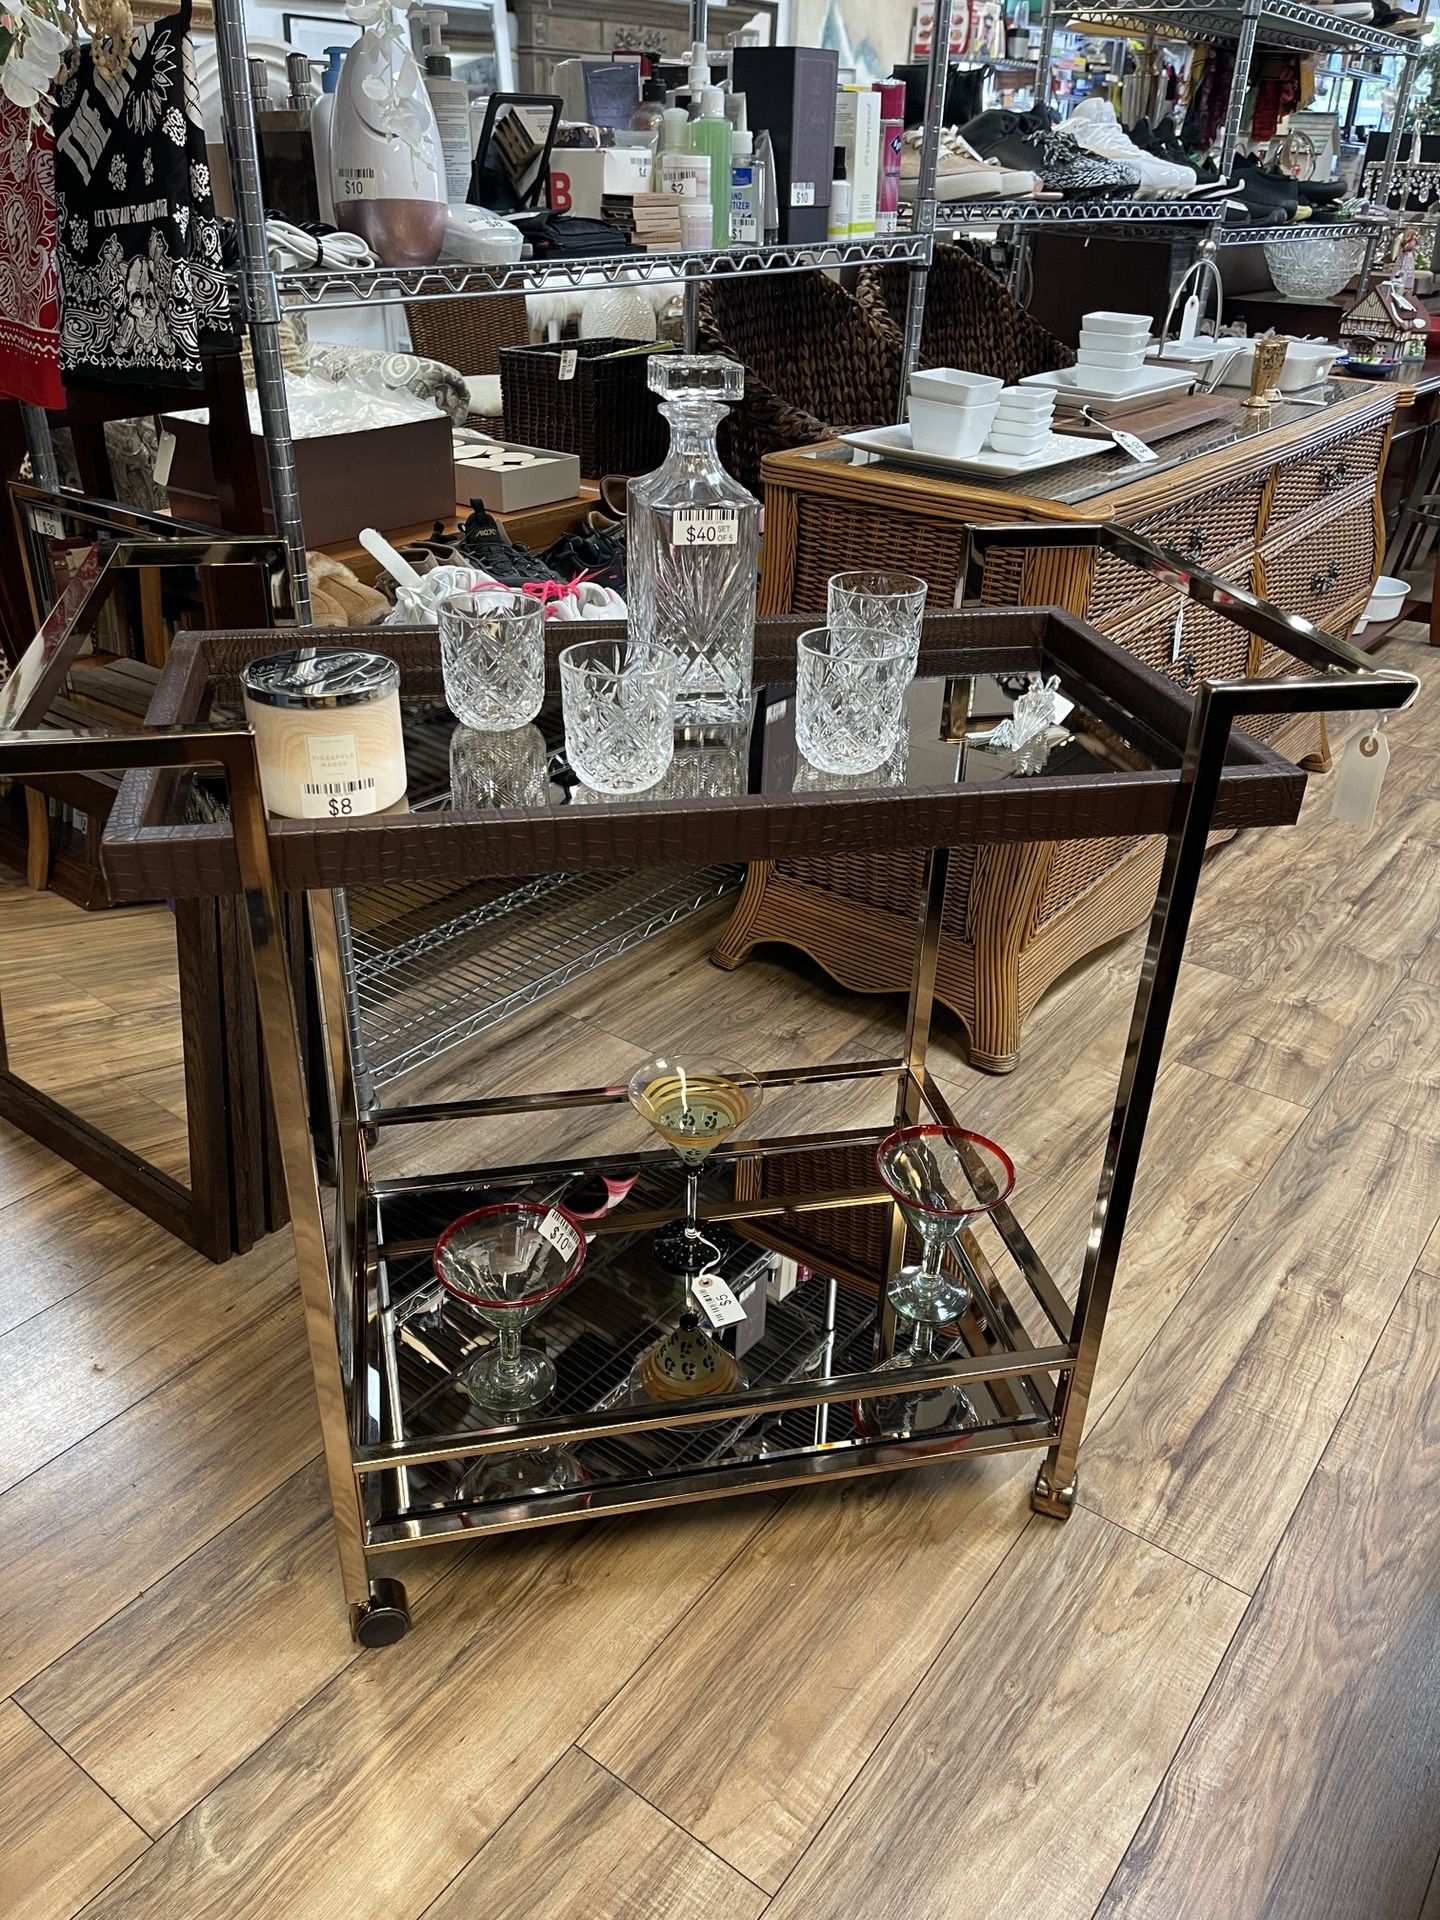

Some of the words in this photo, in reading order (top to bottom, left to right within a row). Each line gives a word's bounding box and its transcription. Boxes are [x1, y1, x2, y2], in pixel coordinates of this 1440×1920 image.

[344, 180, 363, 195] $10
[671, 183, 685, 195] $2
[796, 191, 809, 204] $10
[731, 228, 742, 240] $1
[686, 525, 716, 543] $40
[717, 525, 730, 533] SET
[717, 534, 727, 542] OF
[328, 797, 353, 817] $8
[549, 1226, 570, 1250] $10
[715, 1293, 732, 1307] $5
